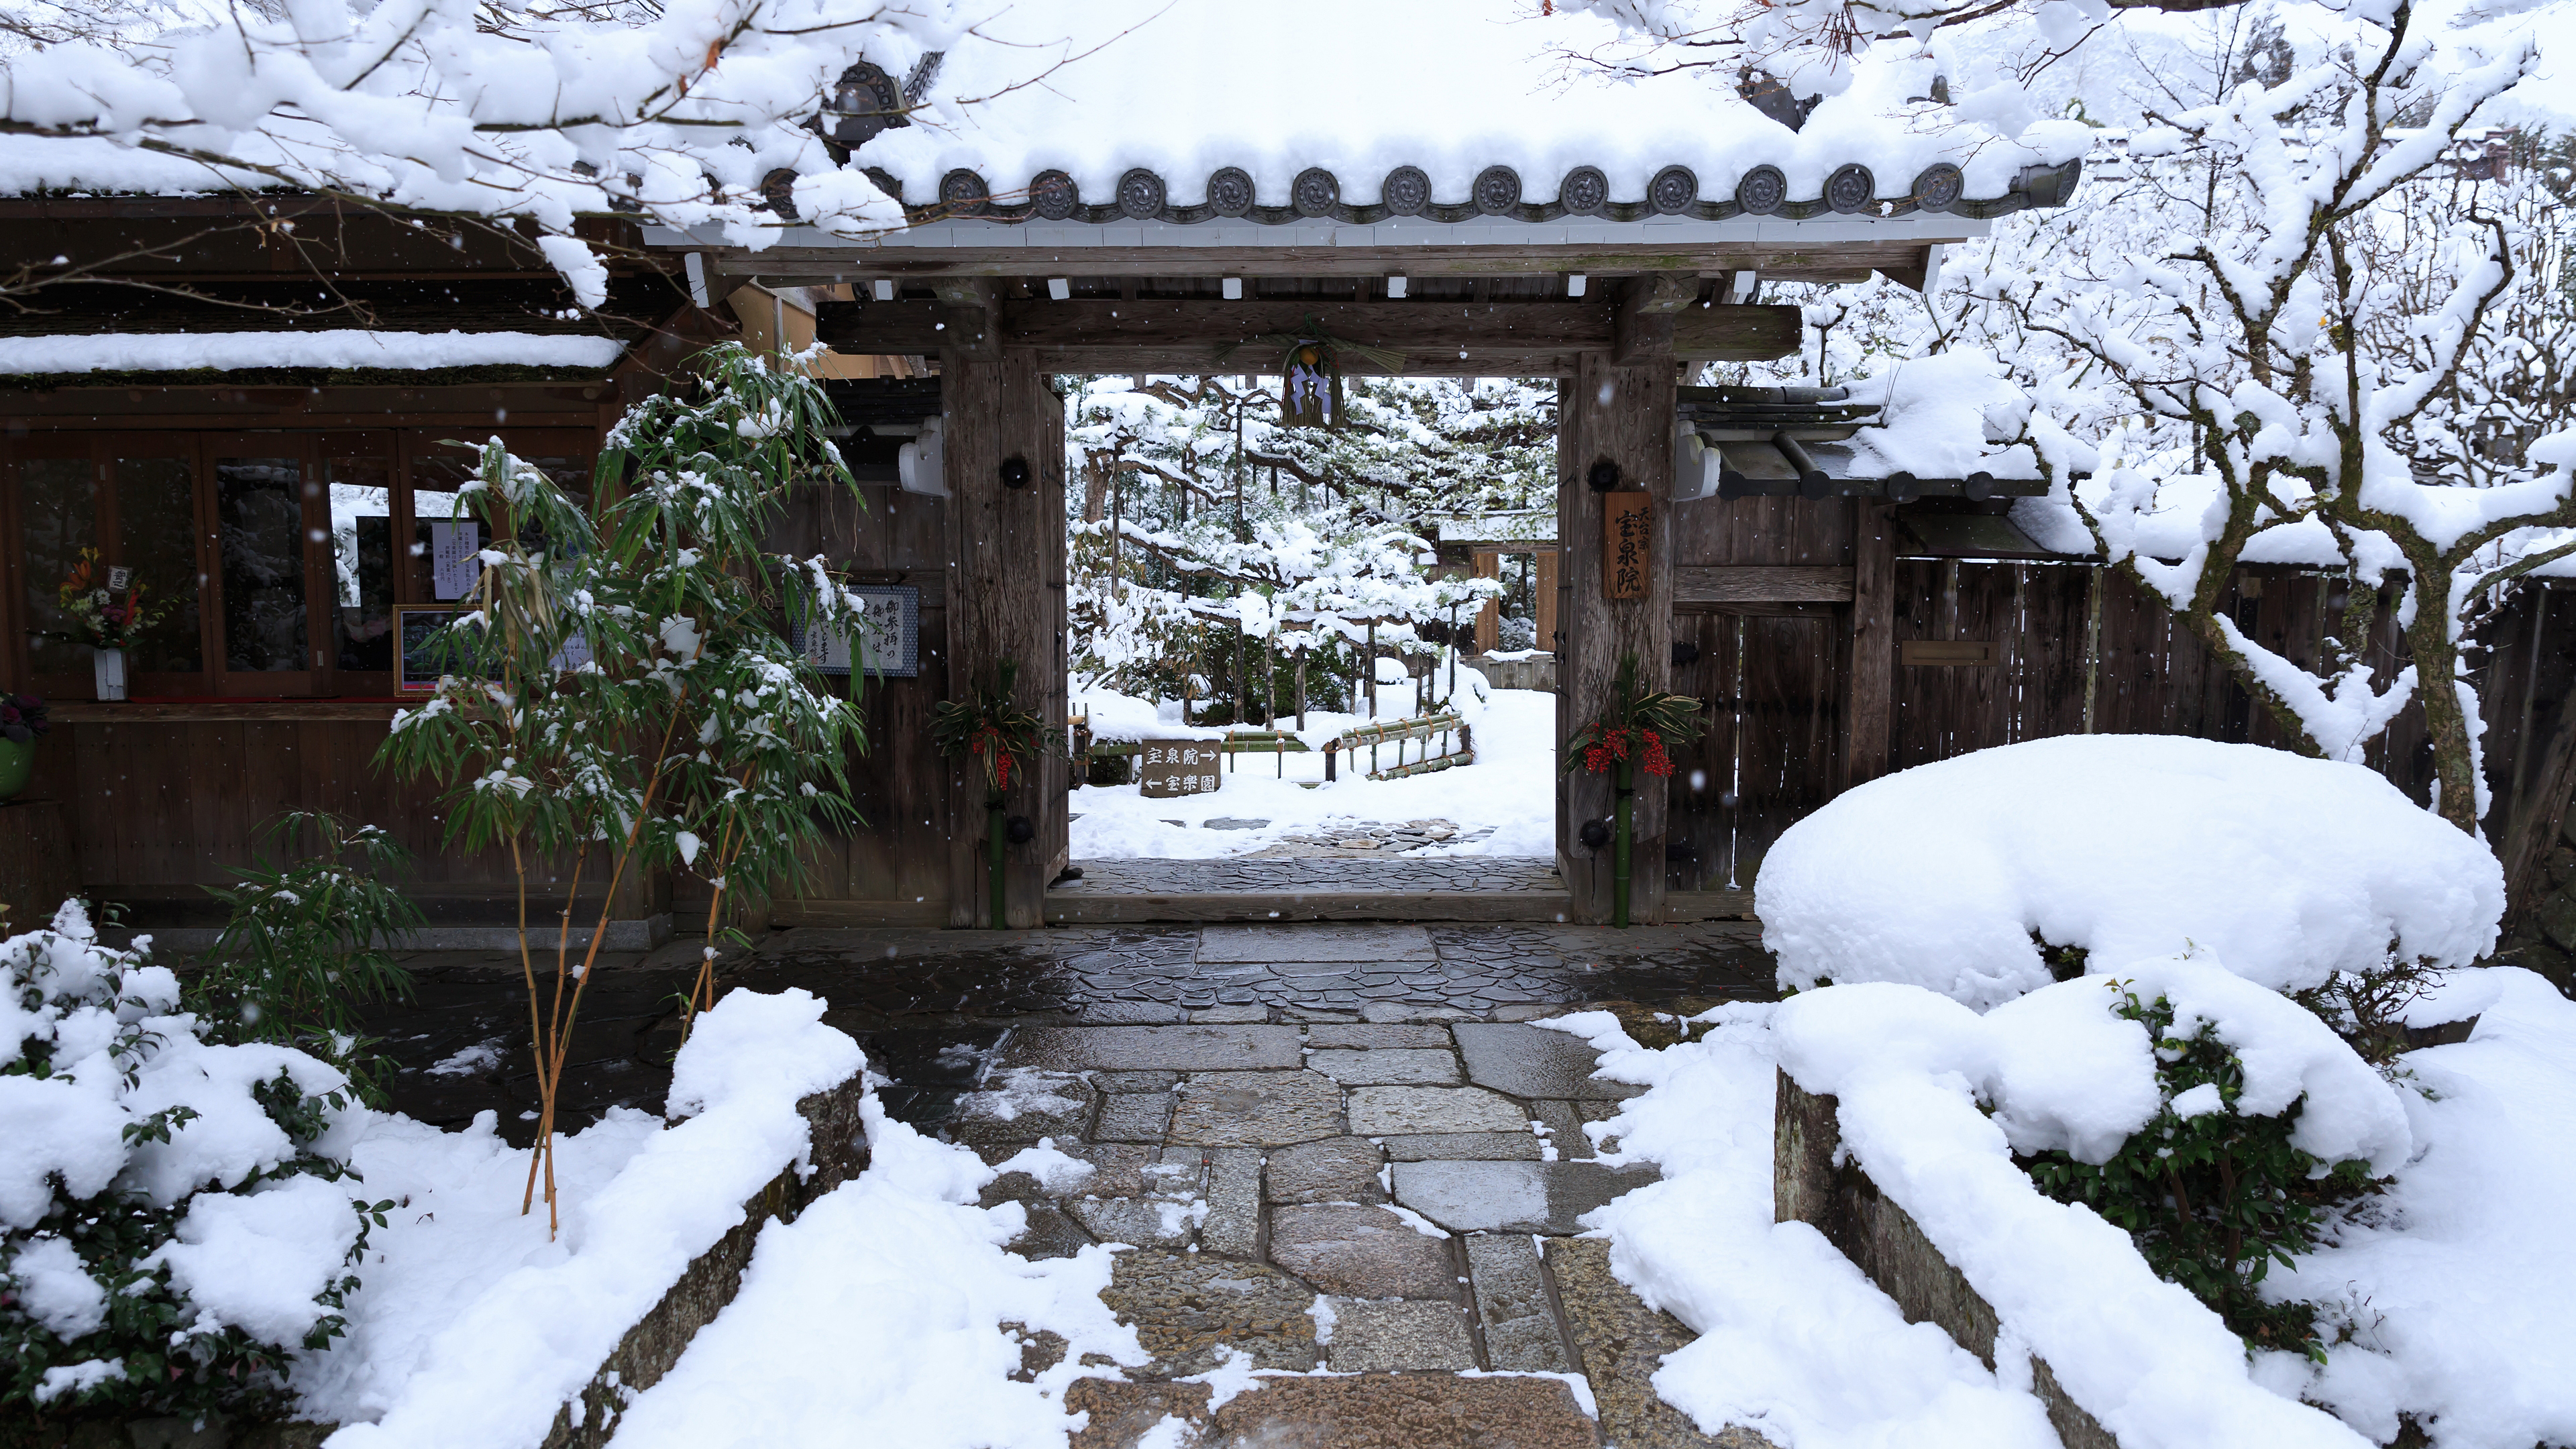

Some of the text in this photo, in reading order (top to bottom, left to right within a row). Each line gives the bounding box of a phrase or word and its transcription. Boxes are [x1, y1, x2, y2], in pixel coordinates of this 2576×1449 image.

[1638, 506, 1650, 549] 天台宗
[1615, 510, 1640, 593] 宝泉院
[1146, 747, 1199, 765] 宝泉院
[1165, 775, 1216, 792] 宝楽園
